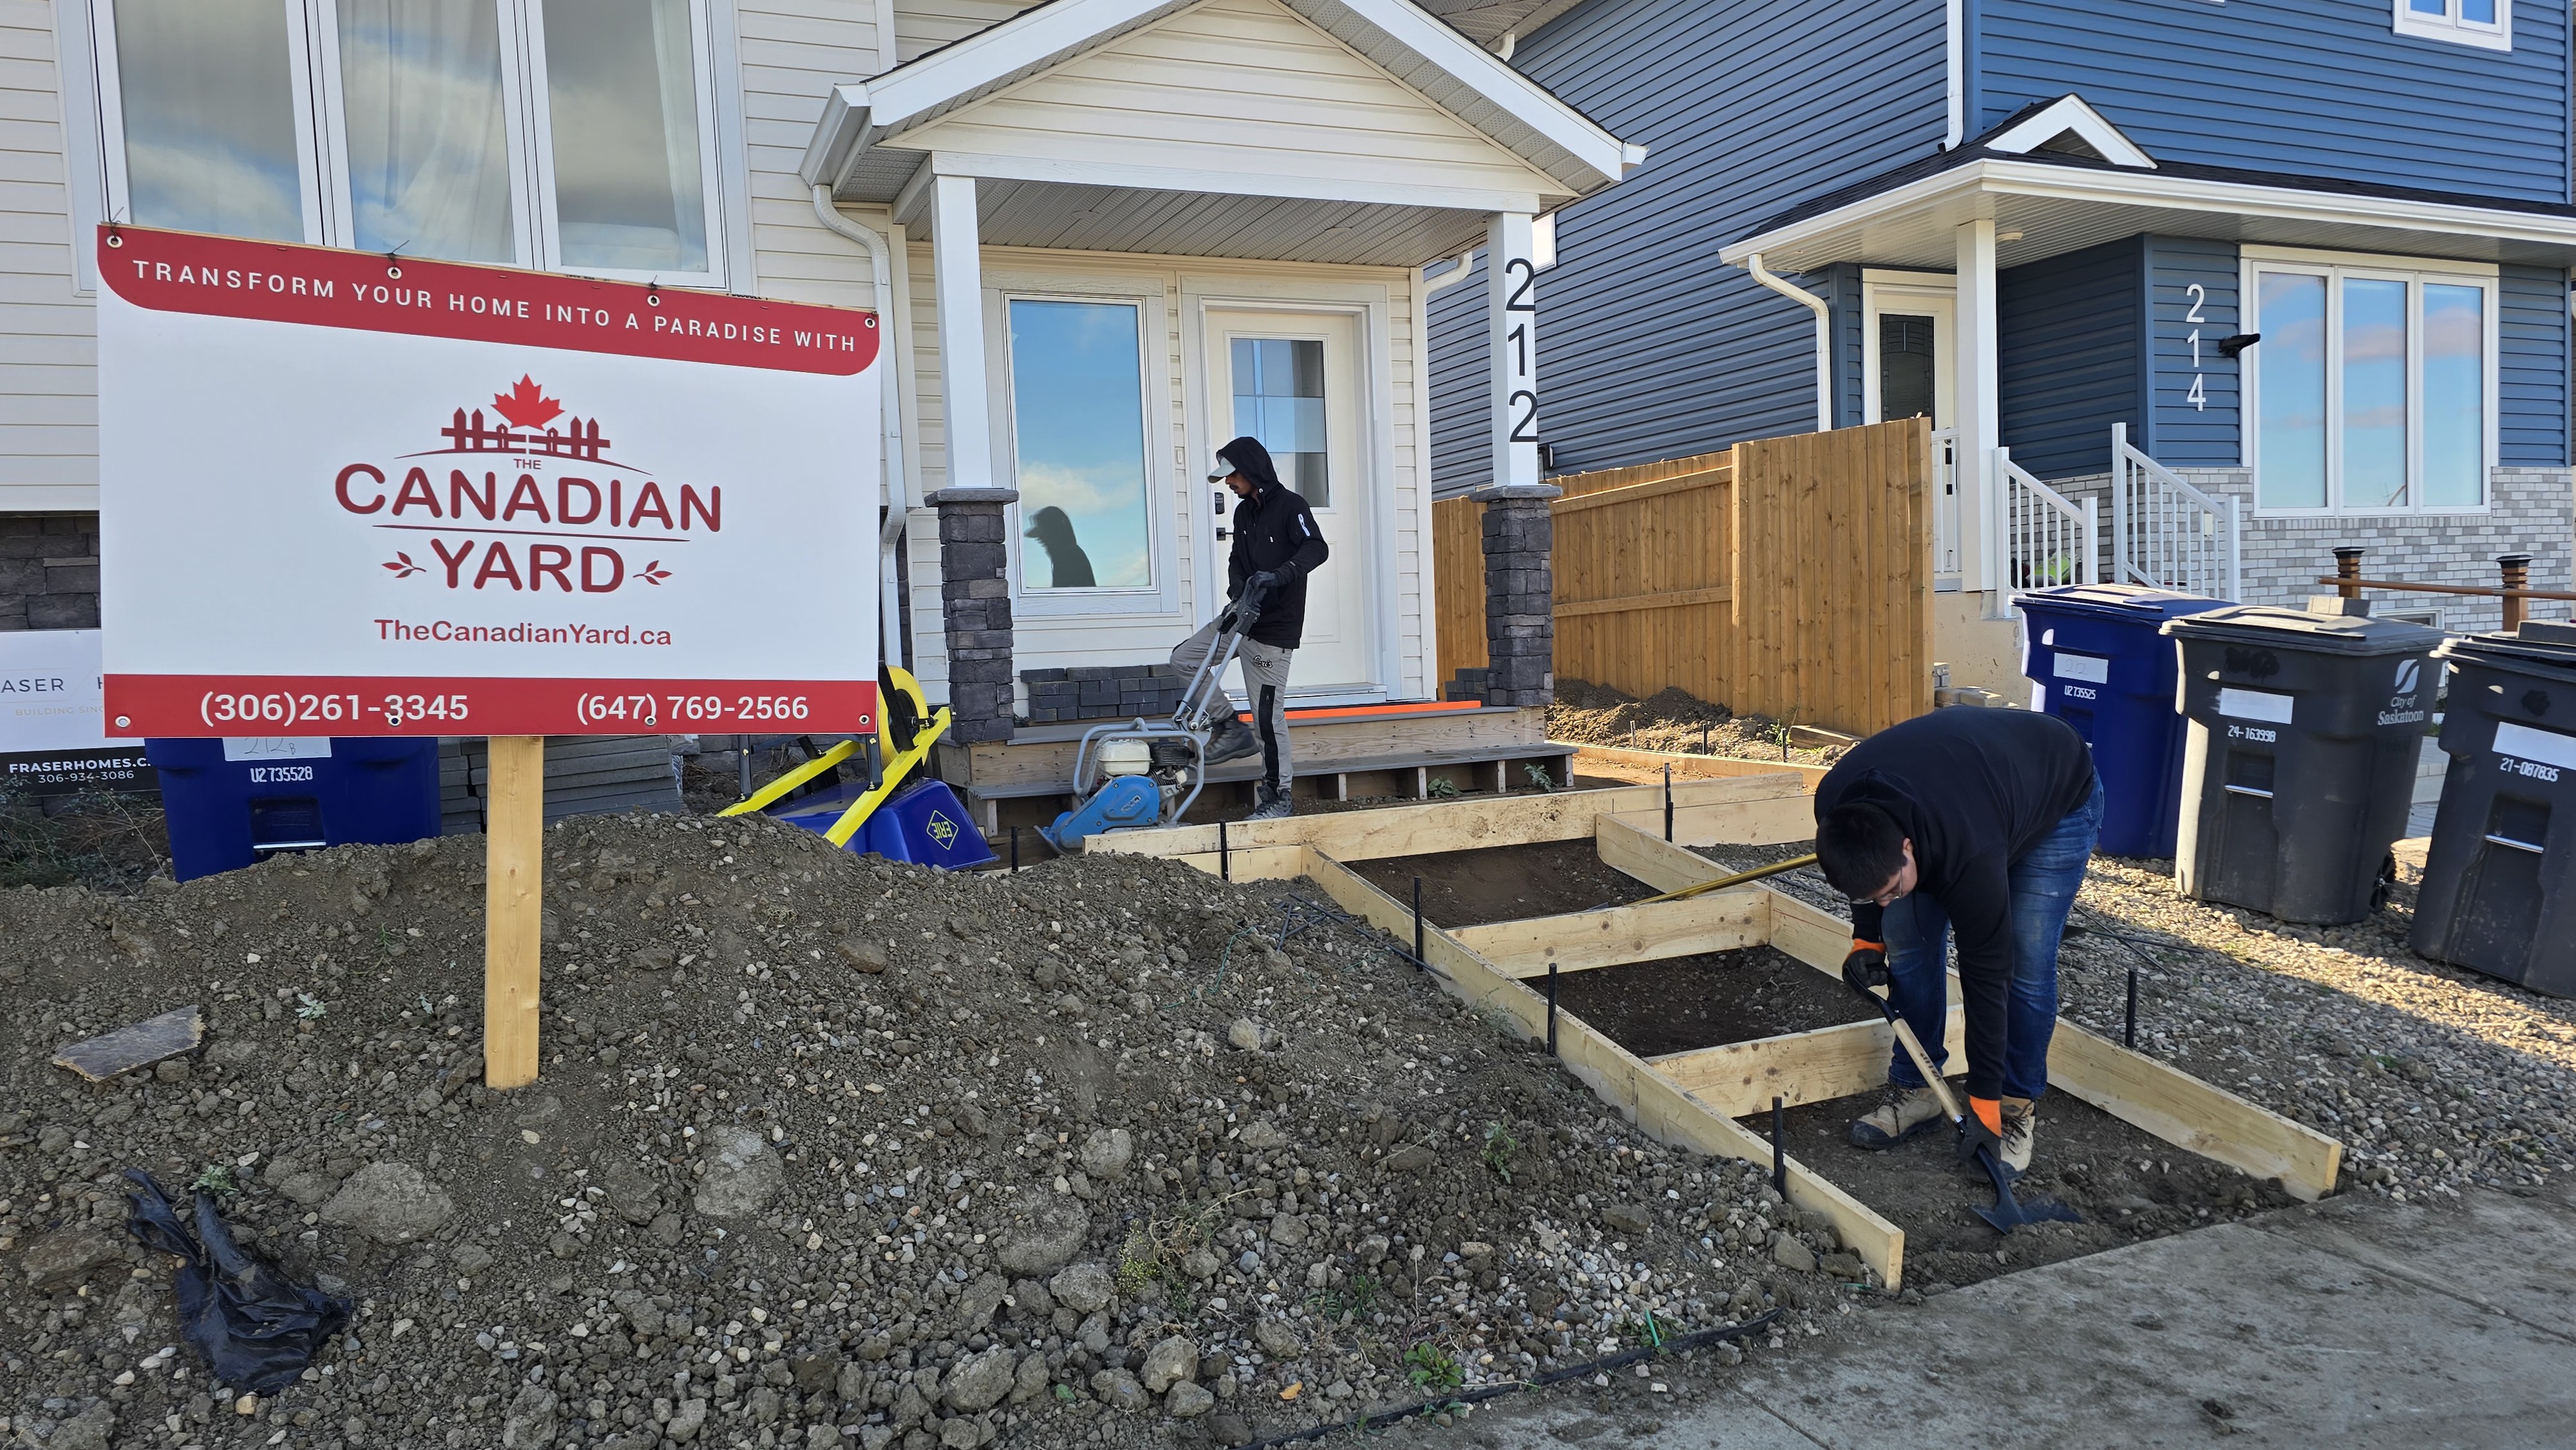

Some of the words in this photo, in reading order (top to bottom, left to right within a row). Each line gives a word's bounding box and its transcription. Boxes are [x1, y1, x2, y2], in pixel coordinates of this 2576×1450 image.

[133, 259, 334, 298] TRANSFORM
[352, 283, 432, 309] YOUR
[450, 294, 530, 319] HOME
[546, 304, 610, 327] INTO
[625, 313, 639, 330] A
[654, 315, 781, 345] PARADISE
[794, 330, 855, 352] WITH
[1505, 258, 1539, 442] 212
[2186, 283, 2206, 411] 214
[513, 458, 542, 470] THE
[334, 462, 721, 532] CANADIAN
[430, 538, 625, 593] YARD
[374, 619, 672, 645] TheCanadianYard.ca
[15, 707, 74, 717] BUILDING
[201, 691, 469, 728] (306)261-3345
[577, 692, 657, 726] (647)
[667, 695, 810, 720] 769-2566
[2391, 696, 2407, 709] City
[2407, 694, 2418, 708] of
[2377, 710, 2425, 726] Saskatoon
[9, 757, 151, 773] FRASERHOMES.C
[38, 770, 135, 784] 306-934-3086
[2499, 757, 2560, 782] 21-087835
[931, 821, 953, 840] ERIE
